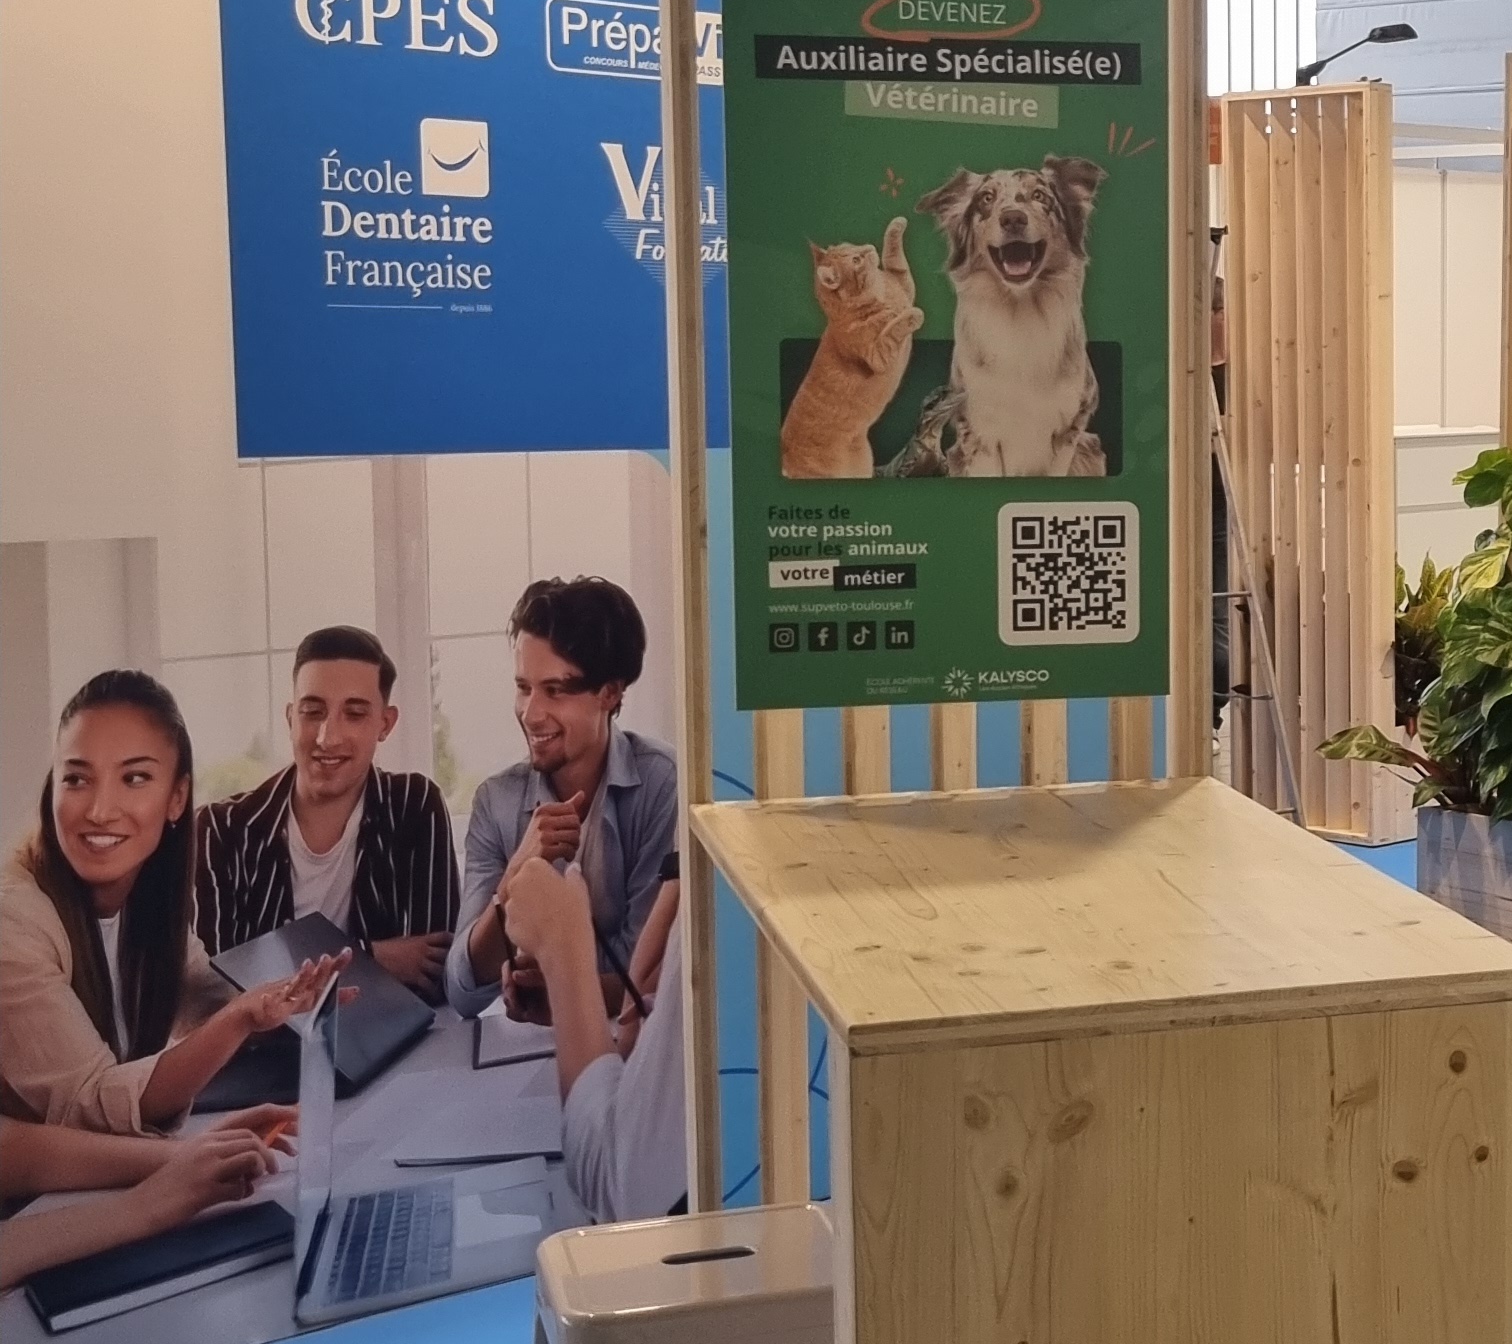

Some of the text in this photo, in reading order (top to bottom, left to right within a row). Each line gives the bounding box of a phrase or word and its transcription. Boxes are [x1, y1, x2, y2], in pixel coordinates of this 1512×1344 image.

[898, 0, 1007, 25] DEVENEZ
[697, 65, 721, 77] ASS
[776, 45, 1122, 81] Auxiliaire Spécialisé(e)
[866, 83, 1039, 117] Vétérinaire
[320, 148, 413, 195] École
[600, 141, 718, 225] Vil
[320, 200, 493, 244] Dentaire
[324, 250, 492, 298] Française
[768, 506, 850, 520] Faites de
[768, 521, 893, 542] votre passion
[768, 540, 929, 562] pour les animaux
[780, 567, 905, 586] votre métier
[768, 599, 914, 615] www.supveto-toulouse.fr
[978, 669, 1050, 684] KALYSCO
